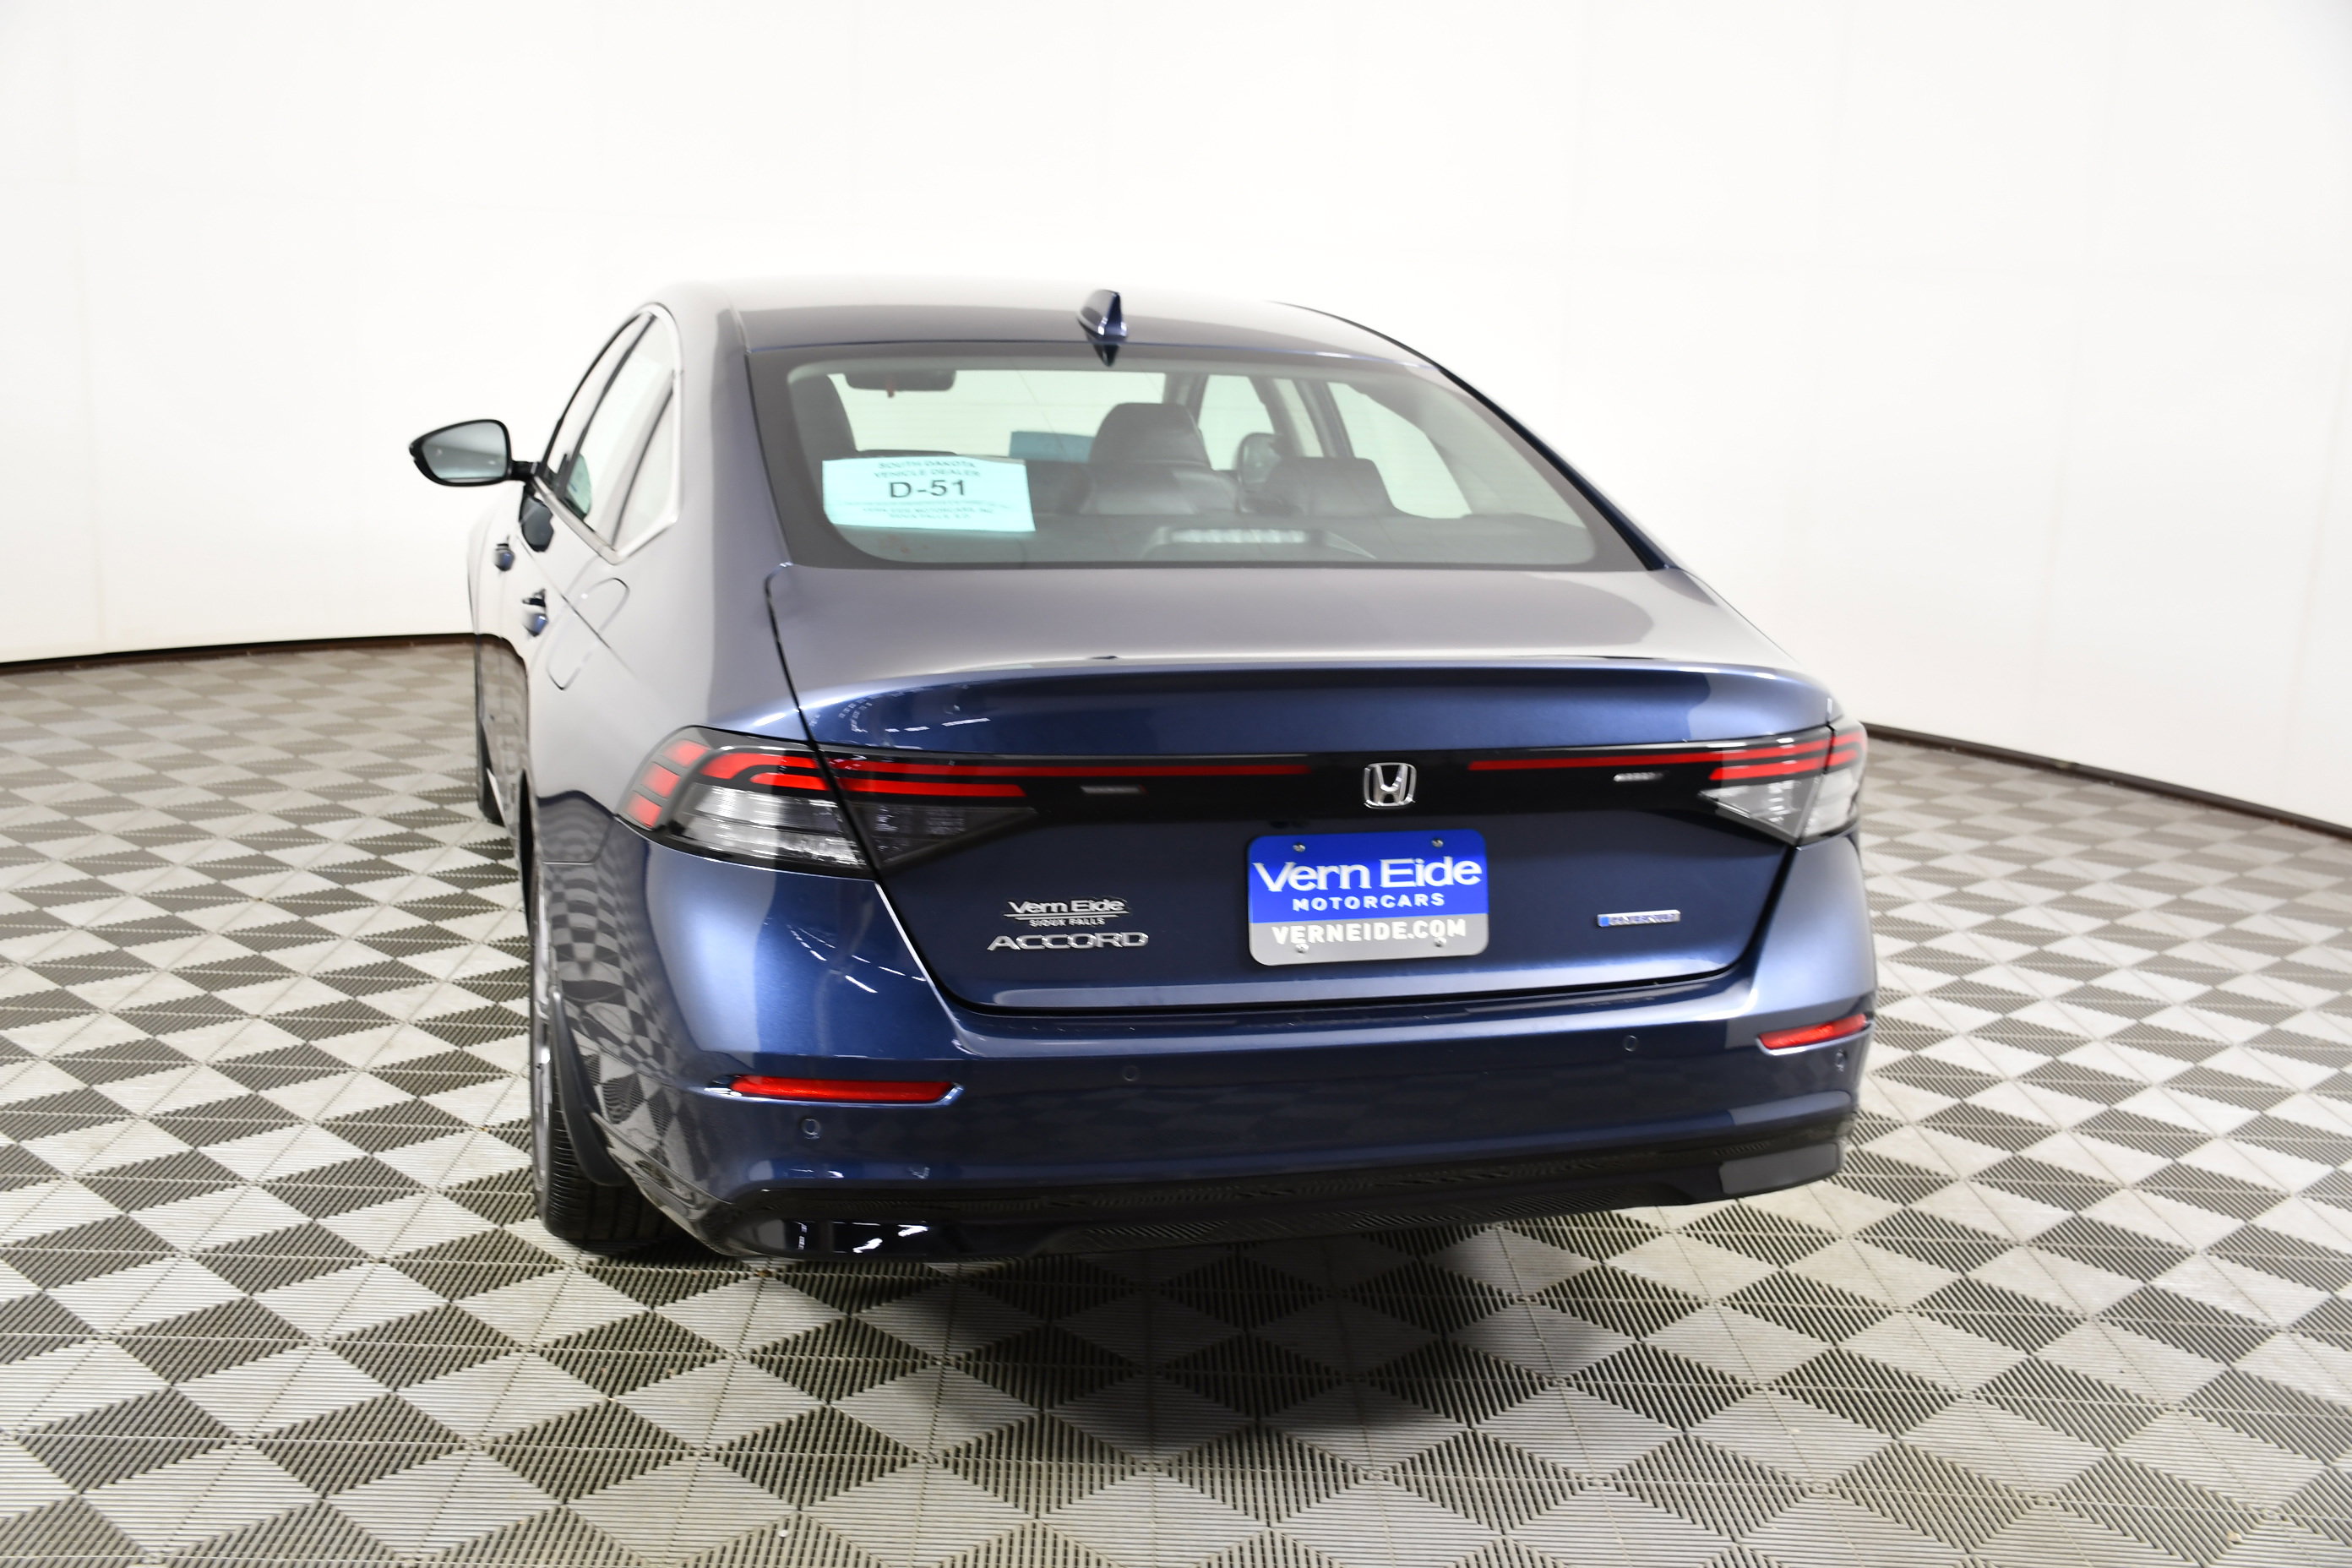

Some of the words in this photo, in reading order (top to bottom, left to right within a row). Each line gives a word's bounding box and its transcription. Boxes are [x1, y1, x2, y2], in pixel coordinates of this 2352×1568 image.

[890, 480, 965, 498] D-51
[1252, 861, 1372, 892] Vern
[1380, 856, 1483, 888] Eide
[1008, 901, 1068, 914] Vern
[1070, 899, 1125, 912] Eide
[1292, 893, 1446, 912] MOTORCARS
[1028, 918, 1067, 928] SIOUX
[1068, 917, 1106, 927] FALLS
[1271, 919, 1467, 945] VERNEIDE.COM
[987, 932, 1149, 951] ACCORD
